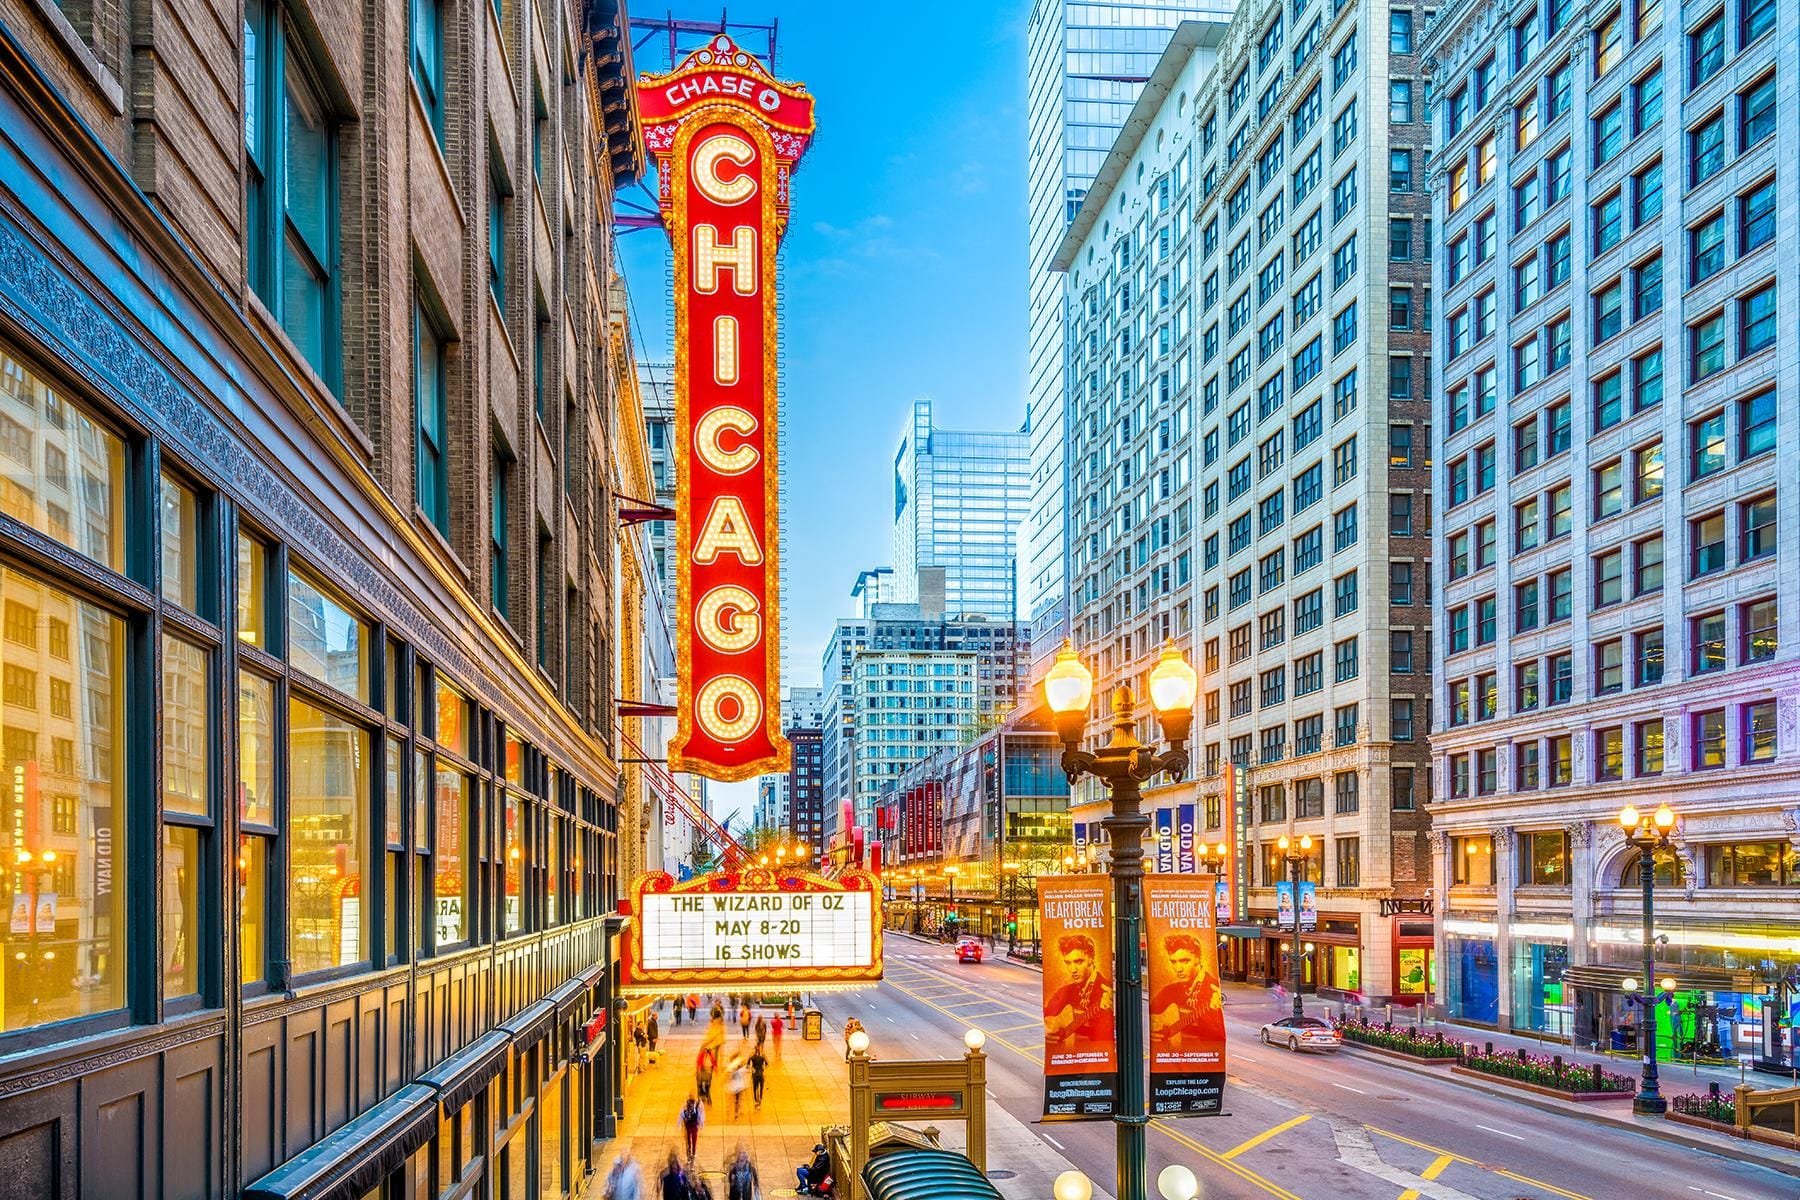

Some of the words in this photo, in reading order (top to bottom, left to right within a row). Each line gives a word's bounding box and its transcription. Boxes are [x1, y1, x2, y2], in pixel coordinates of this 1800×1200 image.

[665, 76, 756, 106] CHASE
[690, 134, 764, 744] CHICAGO
[1235, 768, 1243, 802] GENE
[664, 772, 677, 826] Walgre
[1160, 826, 1171, 851] OLD
[1181, 823, 1193, 849] OLD
[1236, 806, 1244, 858] SISKEL
[1160, 853, 1172, 873] NA
[1181, 851, 1193, 873] NA
[671, 896, 704, 912] THE
[713, 896, 782, 912] WIZARD
[792, 895, 813, 911] OF
[822, 895, 844, 911] OZ
[1044, 900, 1104, 919] HEARTBREAK
[1151, 900, 1211, 918] HEARTBREAK
[715, 920, 752, 936] MAY
[760, 920, 801, 935] 8-20
[1064, 918, 1104, 929] HOTEL
[1170, 918, 1211, 929] HOTEL
[715, 945, 732, 960] 16
[741, 944, 801, 960] SHOWS
[901, 1092, 936, 1102] SUBWAY
[1155, 1087, 1219, 1097] LoopChicago.com
